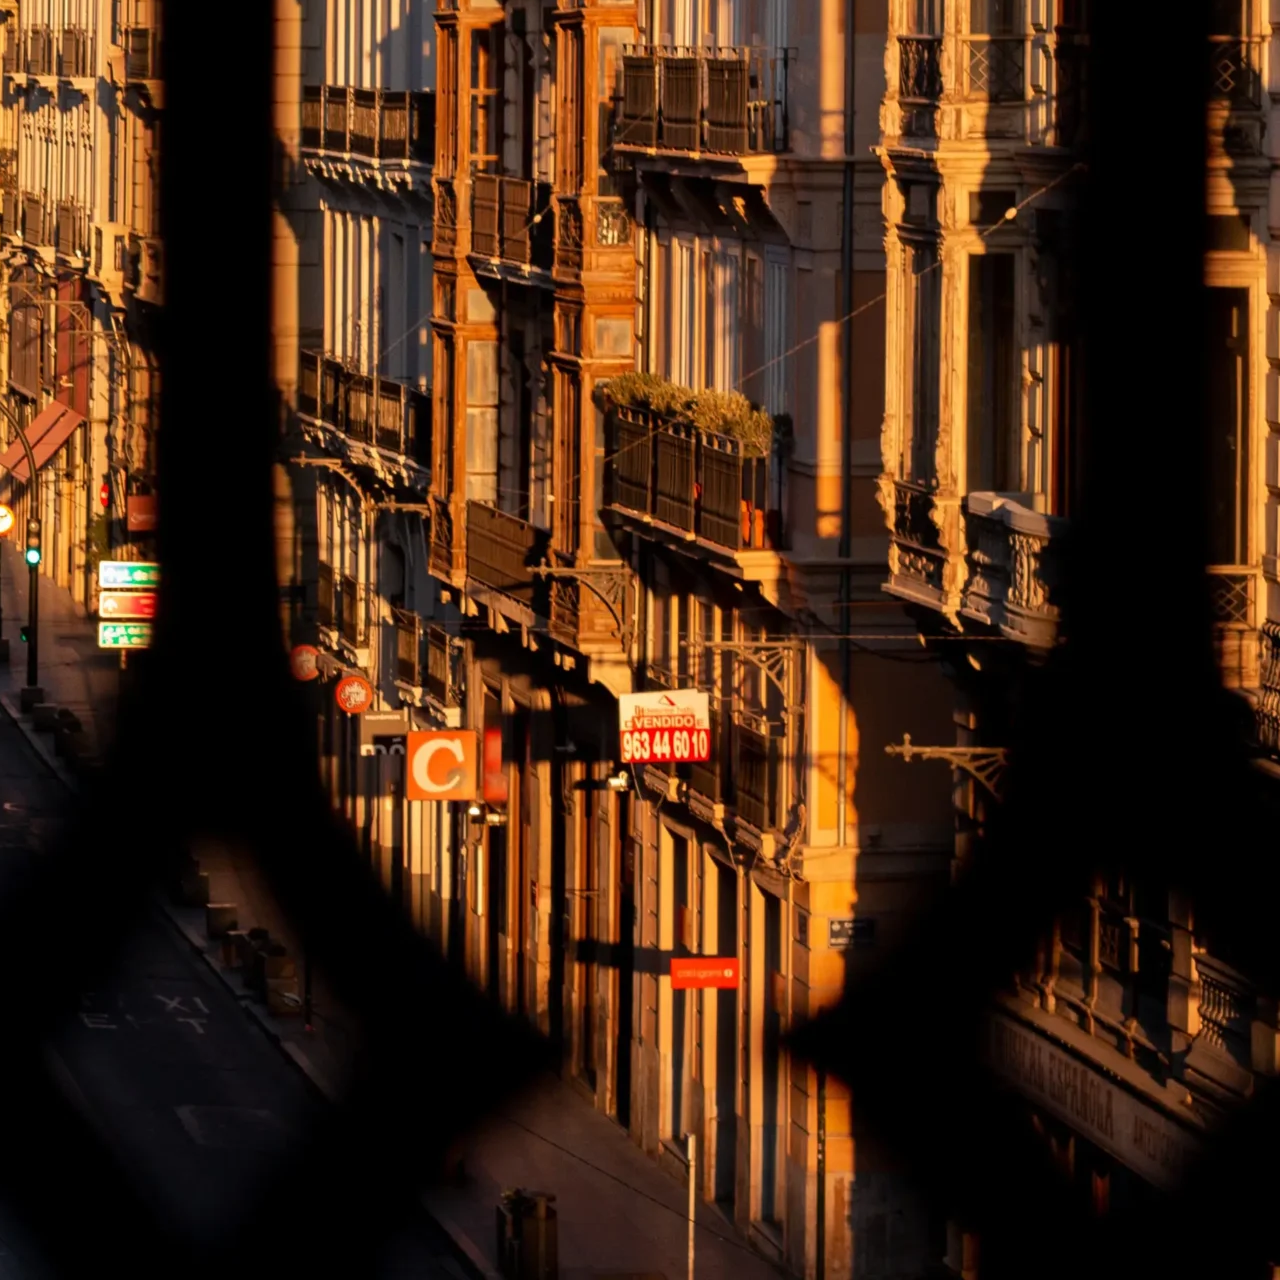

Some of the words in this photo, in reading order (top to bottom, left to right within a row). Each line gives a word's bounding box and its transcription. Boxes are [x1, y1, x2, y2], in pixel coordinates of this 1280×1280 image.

[634, 716, 694, 728] VENDIDO
[412, 738, 465, 793] C
[623, 731, 650, 760] 963
[653, 731, 671, 759] 44
[673, 730, 690, 759] 60
[691, 730, 708, 758] 10
[1048, 1051, 1114, 1141] ESPAÑOLA
